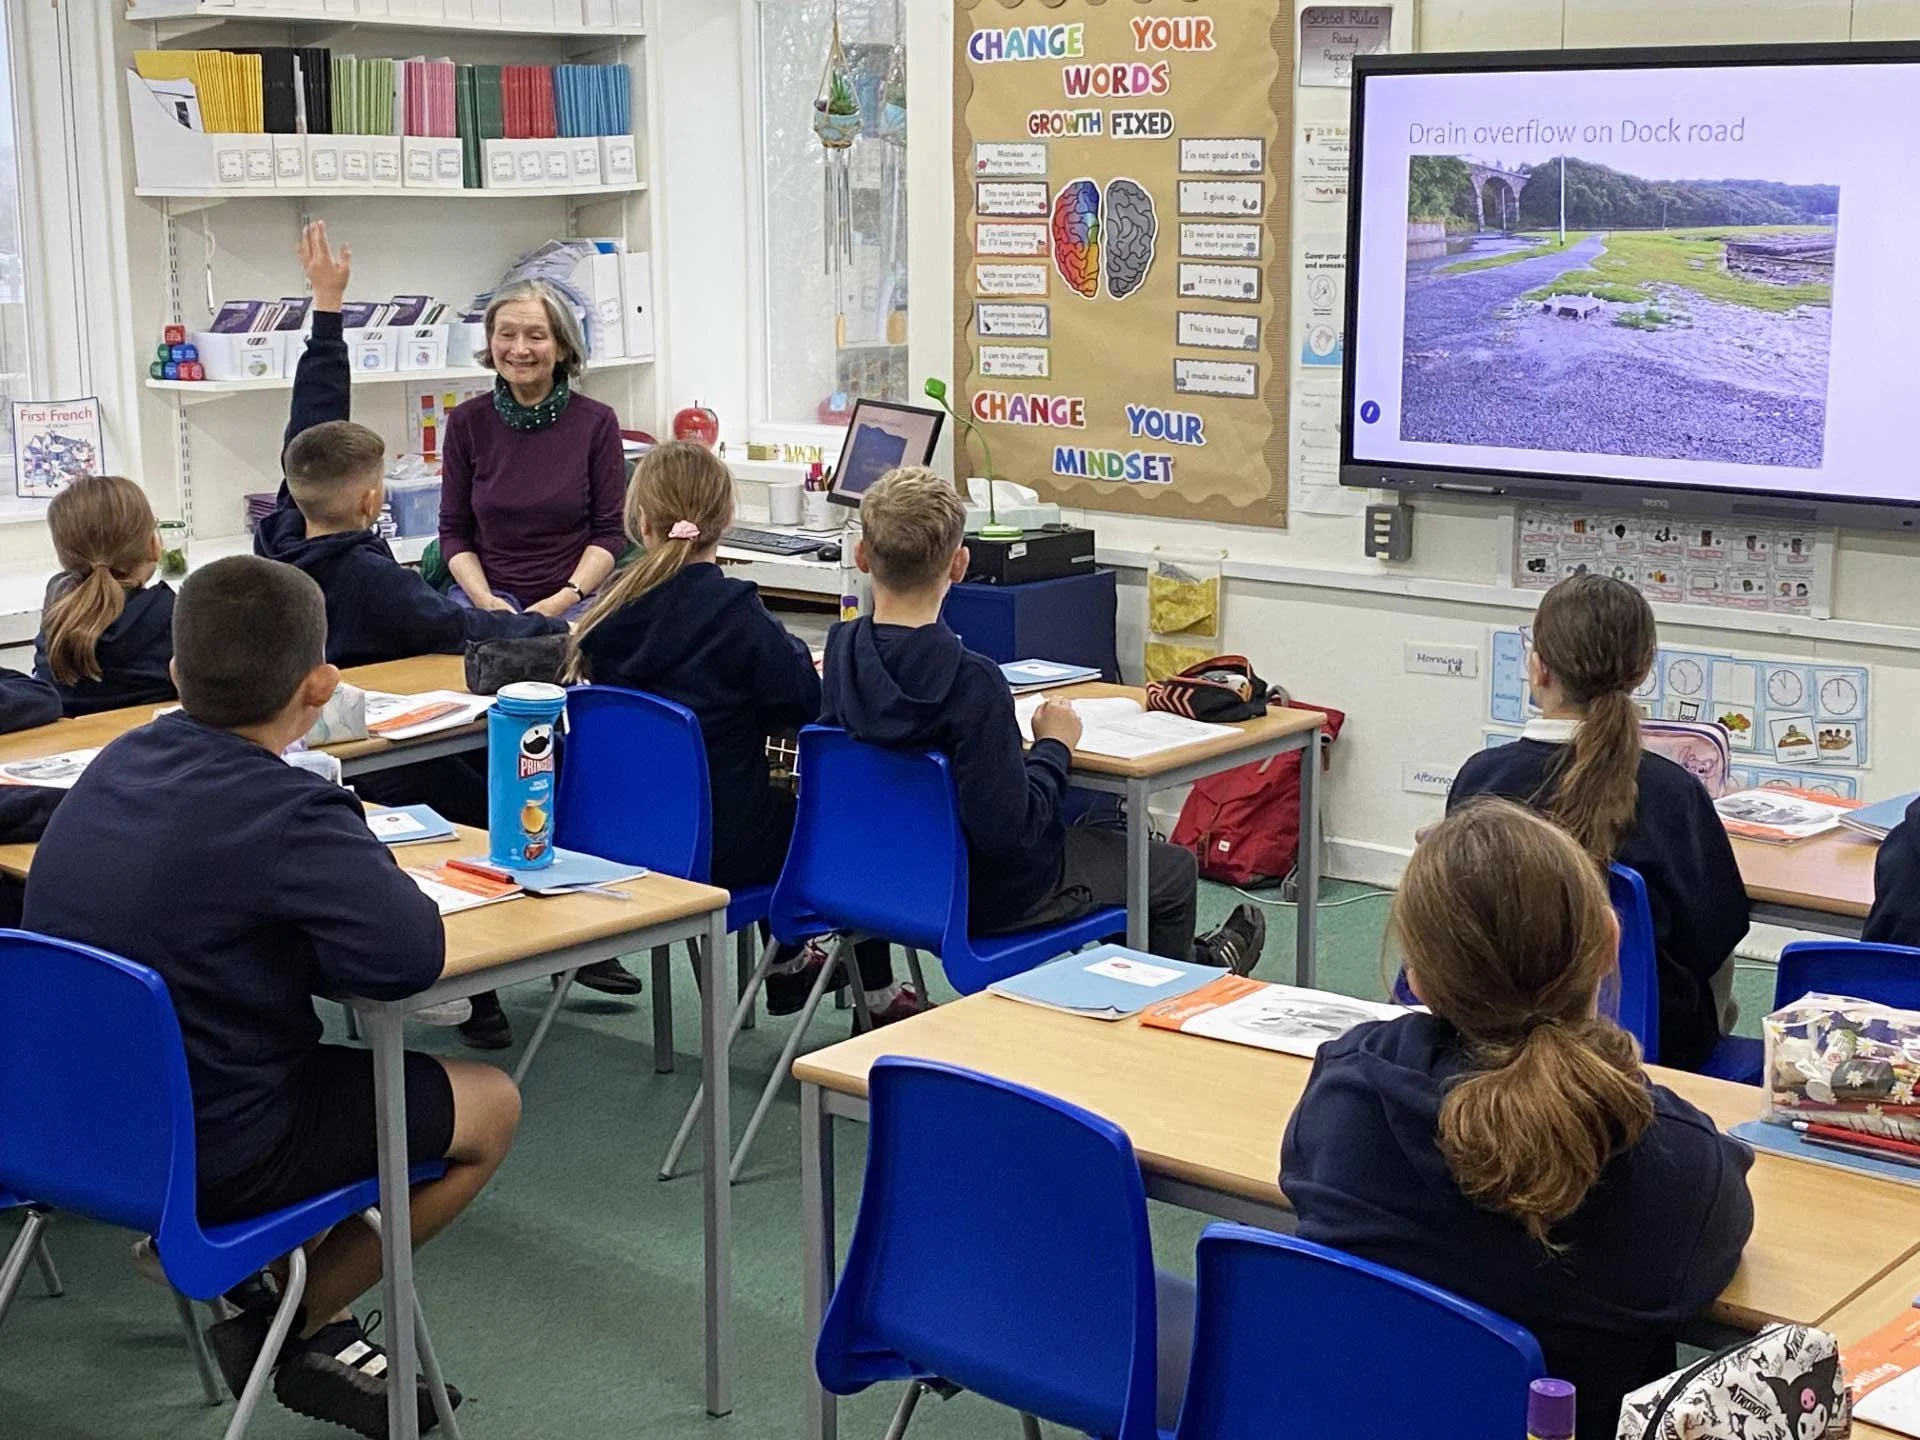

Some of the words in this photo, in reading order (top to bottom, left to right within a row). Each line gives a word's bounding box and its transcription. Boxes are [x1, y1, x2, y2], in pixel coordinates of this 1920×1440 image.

[1307, 9, 1344, 25] School
[1349, 9, 1379, 25] Rules
[969, 25, 1084, 62] CHANGE
[1132, 18, 1214, 50] YOUR
[1332, 31, 1359, 48] Ready
[1064, 63, 1169, 96] WORDS
[1028, 111, 1101, 135] GROWTH
[1111, 111, 1173, 135] FIXED
[1409, 121, 1466, 144] Drain
[1474, 119, 1576, 144] overflow
[1583, 124, 1612, 143] on
[1621, 118, 1681, 143] Dock
[1688, 117, 1745, 143] road
[1211, 152, 1228, 162] good
[1209, 193, 1224, 204] give
[1236, 231, 1256, 239] smart
[1189, 323, 1204, 333] This
[1205, 325, 1212, 333] is
[1213, 326, 1225, 334] too
[1191, 372, 1210, 380] made
[20, 409, 46, 422] First
[51, 406, 92, 422] French
[974, 392, 1085, 427] CHANGE
[1127, 406, 1204, 445] YOUR
[1055, 447, 1173, 482] MINDSET
[1417, 652, 1464, 668] Morning
[1414, 772, 1453, 784] Afterno
[1844, 1363, 1903, 1393] pelling
